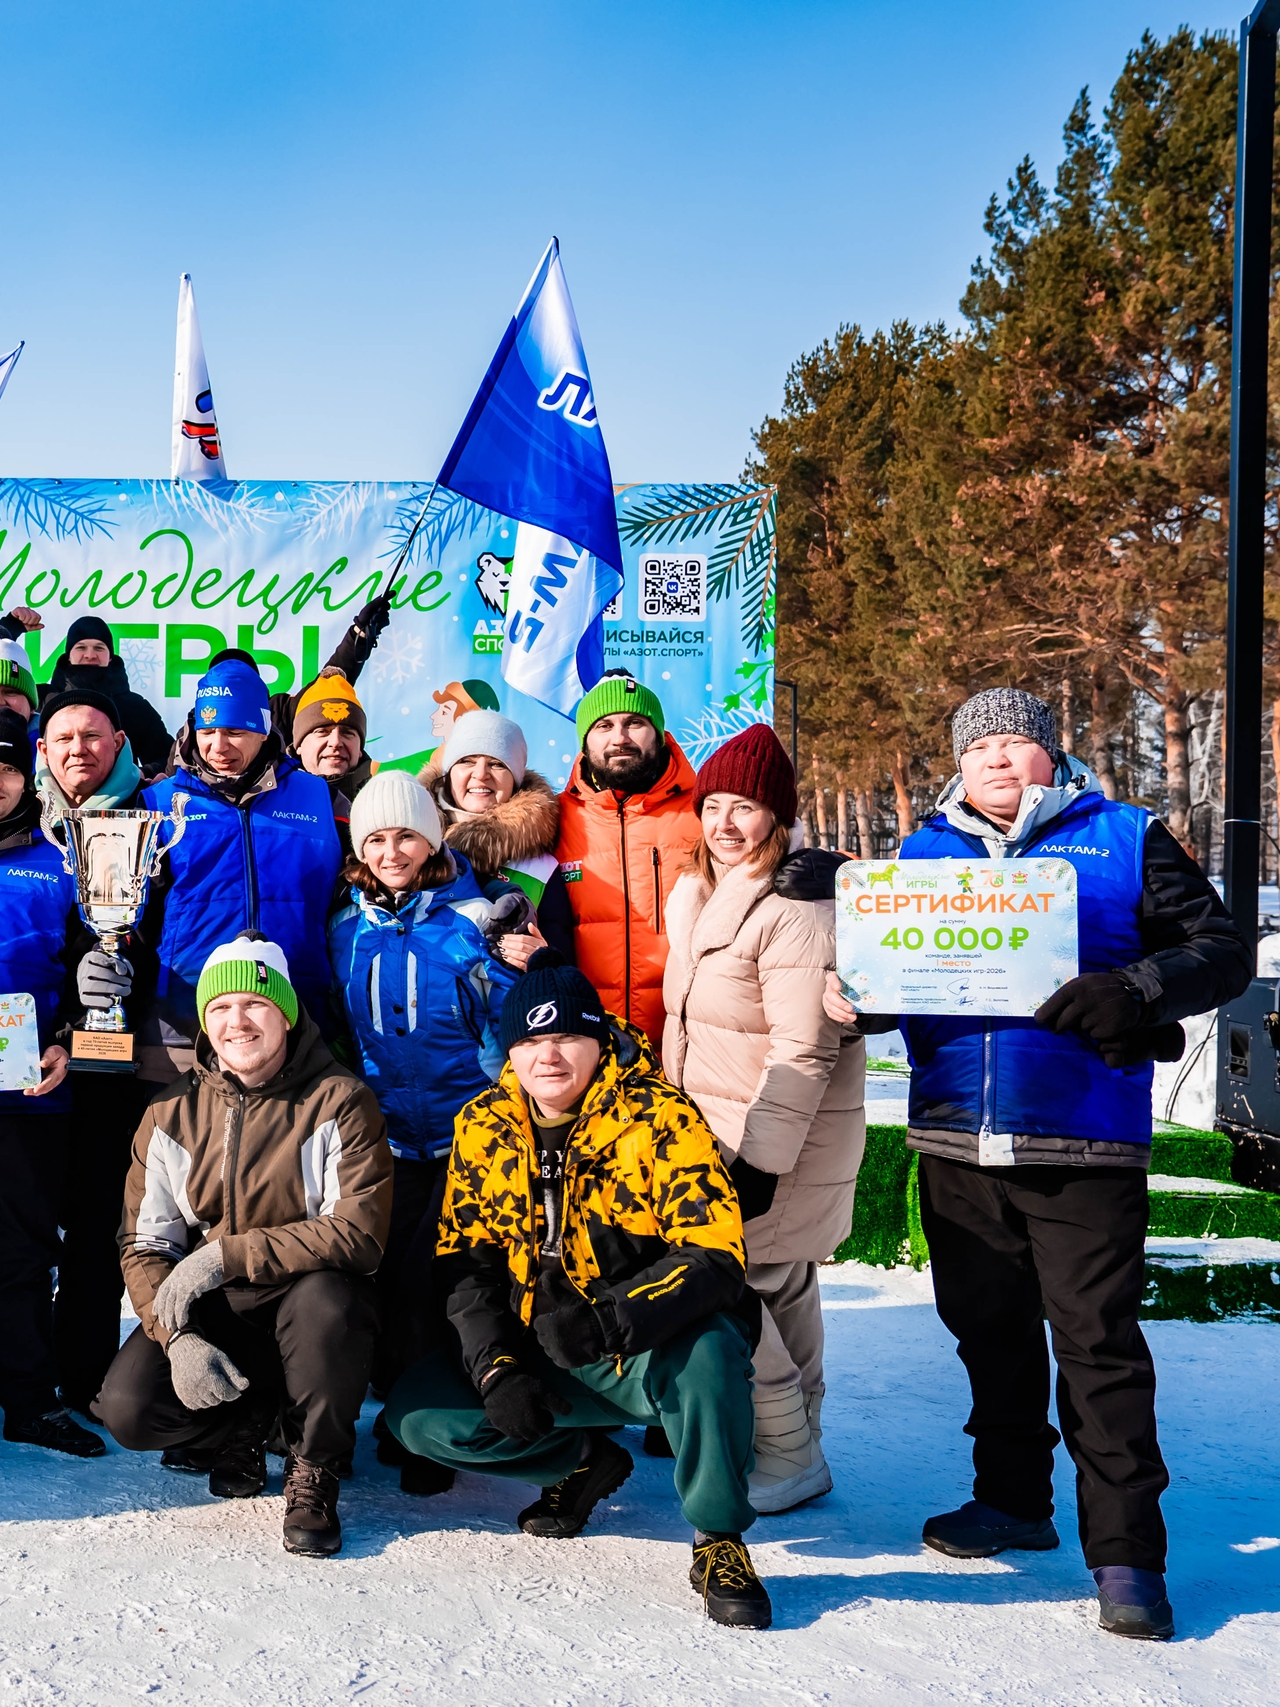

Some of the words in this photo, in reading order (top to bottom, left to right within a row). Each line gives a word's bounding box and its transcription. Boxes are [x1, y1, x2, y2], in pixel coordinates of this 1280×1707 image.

[623, 648, 704, 657] «АЗОТ.СПОРТ»
[197, 686, 232, 698] RUSSIA
[272, 810, 318, 823] ЛАКТАМ-2
[1039, 844, 1110, 857] ЛАКТАМ-2
[7, 868, 59, 883] ЛАКТАМ-2
[906, 880, 938, 888] ИГРЫ
[855, 892, 1055, 915] СЕРТИФИКАТ
[880, 927, 924, 950] 40
[933, 927, 1003, 950] 000
